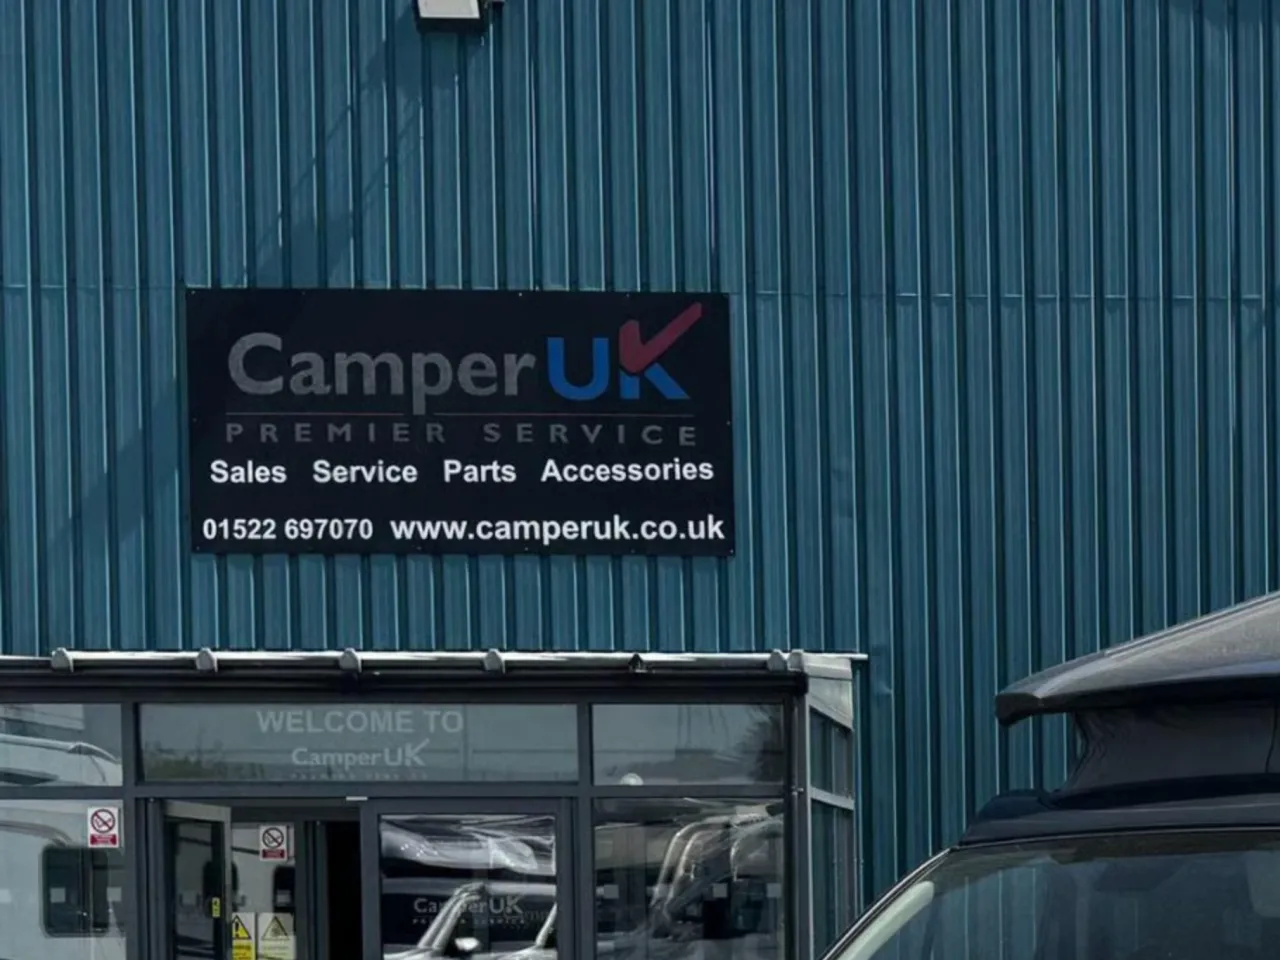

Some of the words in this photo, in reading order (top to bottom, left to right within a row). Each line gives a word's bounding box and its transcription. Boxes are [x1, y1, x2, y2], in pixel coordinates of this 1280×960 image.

[225, 422, 445, 444] PREMIER
[483, 422, 696, 447] SERVICE
[210, 459, 287, 483] Sales
[312, 459, 418, 483] Service
[444, 459, 517, 483] Parts
[541, 458, 714, 483] Accessories
[202, 518, 277, 540] 01522
[284, 518, 374, 541] 697070
[389, 515, 725, 545] www.camperuk.co.uk
[256, 709, 416, 733] WELCOME
[423, 709, 465, 733] TO
